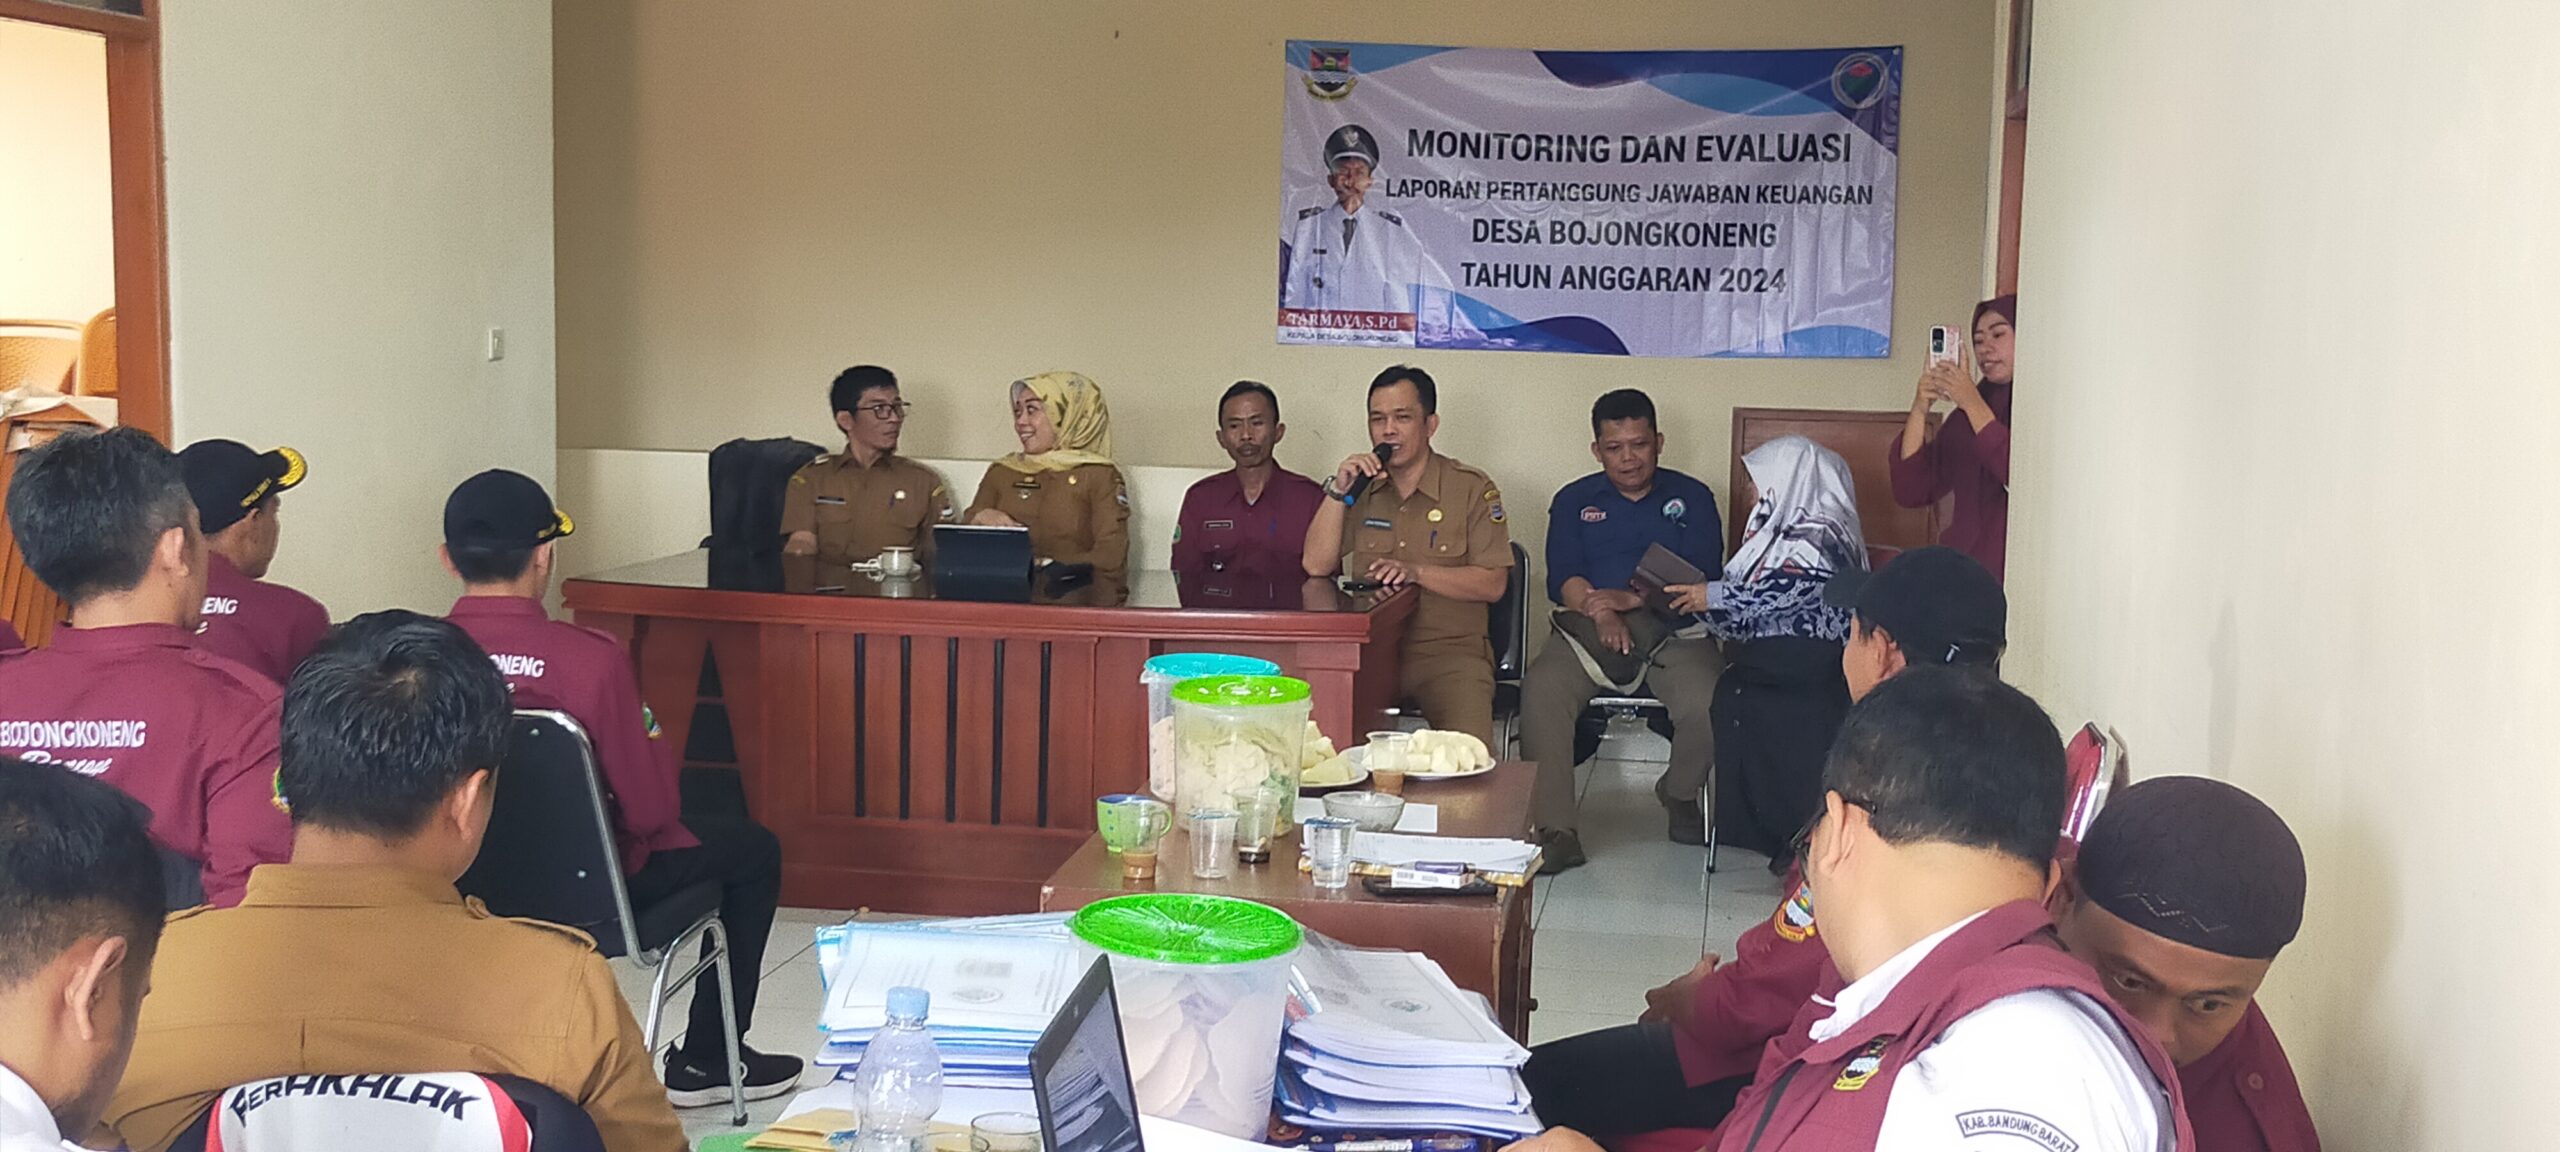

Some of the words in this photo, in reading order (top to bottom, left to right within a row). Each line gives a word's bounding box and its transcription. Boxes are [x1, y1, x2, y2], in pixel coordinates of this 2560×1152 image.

[1408, 129, 1610, 163] MONITORING
[1620, 135, 1686, 163] DAN
[1696, 133, 1851, 163] EVALUASI
[1386, 178, 1480, 200] LAPORAN
[1486, 181, 1641, 203] PERTANGGUNG
[1646, 184, 1750, 204] JAWABAN
[1756, 184, 1873, 205] KEUANGAN
[1472, 218, 1542, 244] DESA
[1550, 220, 1777, 248] BOJONGKONENG
[1461, 262, 1551, 289] TAHUN
[1559, 265, 1712, 292] ANGGARAN
[1719, 267, 1787, 293] 2024
[0, 720, 147, 748] BOJONGKONENG
[2038, 1127, 2071, 1152] BARAT
